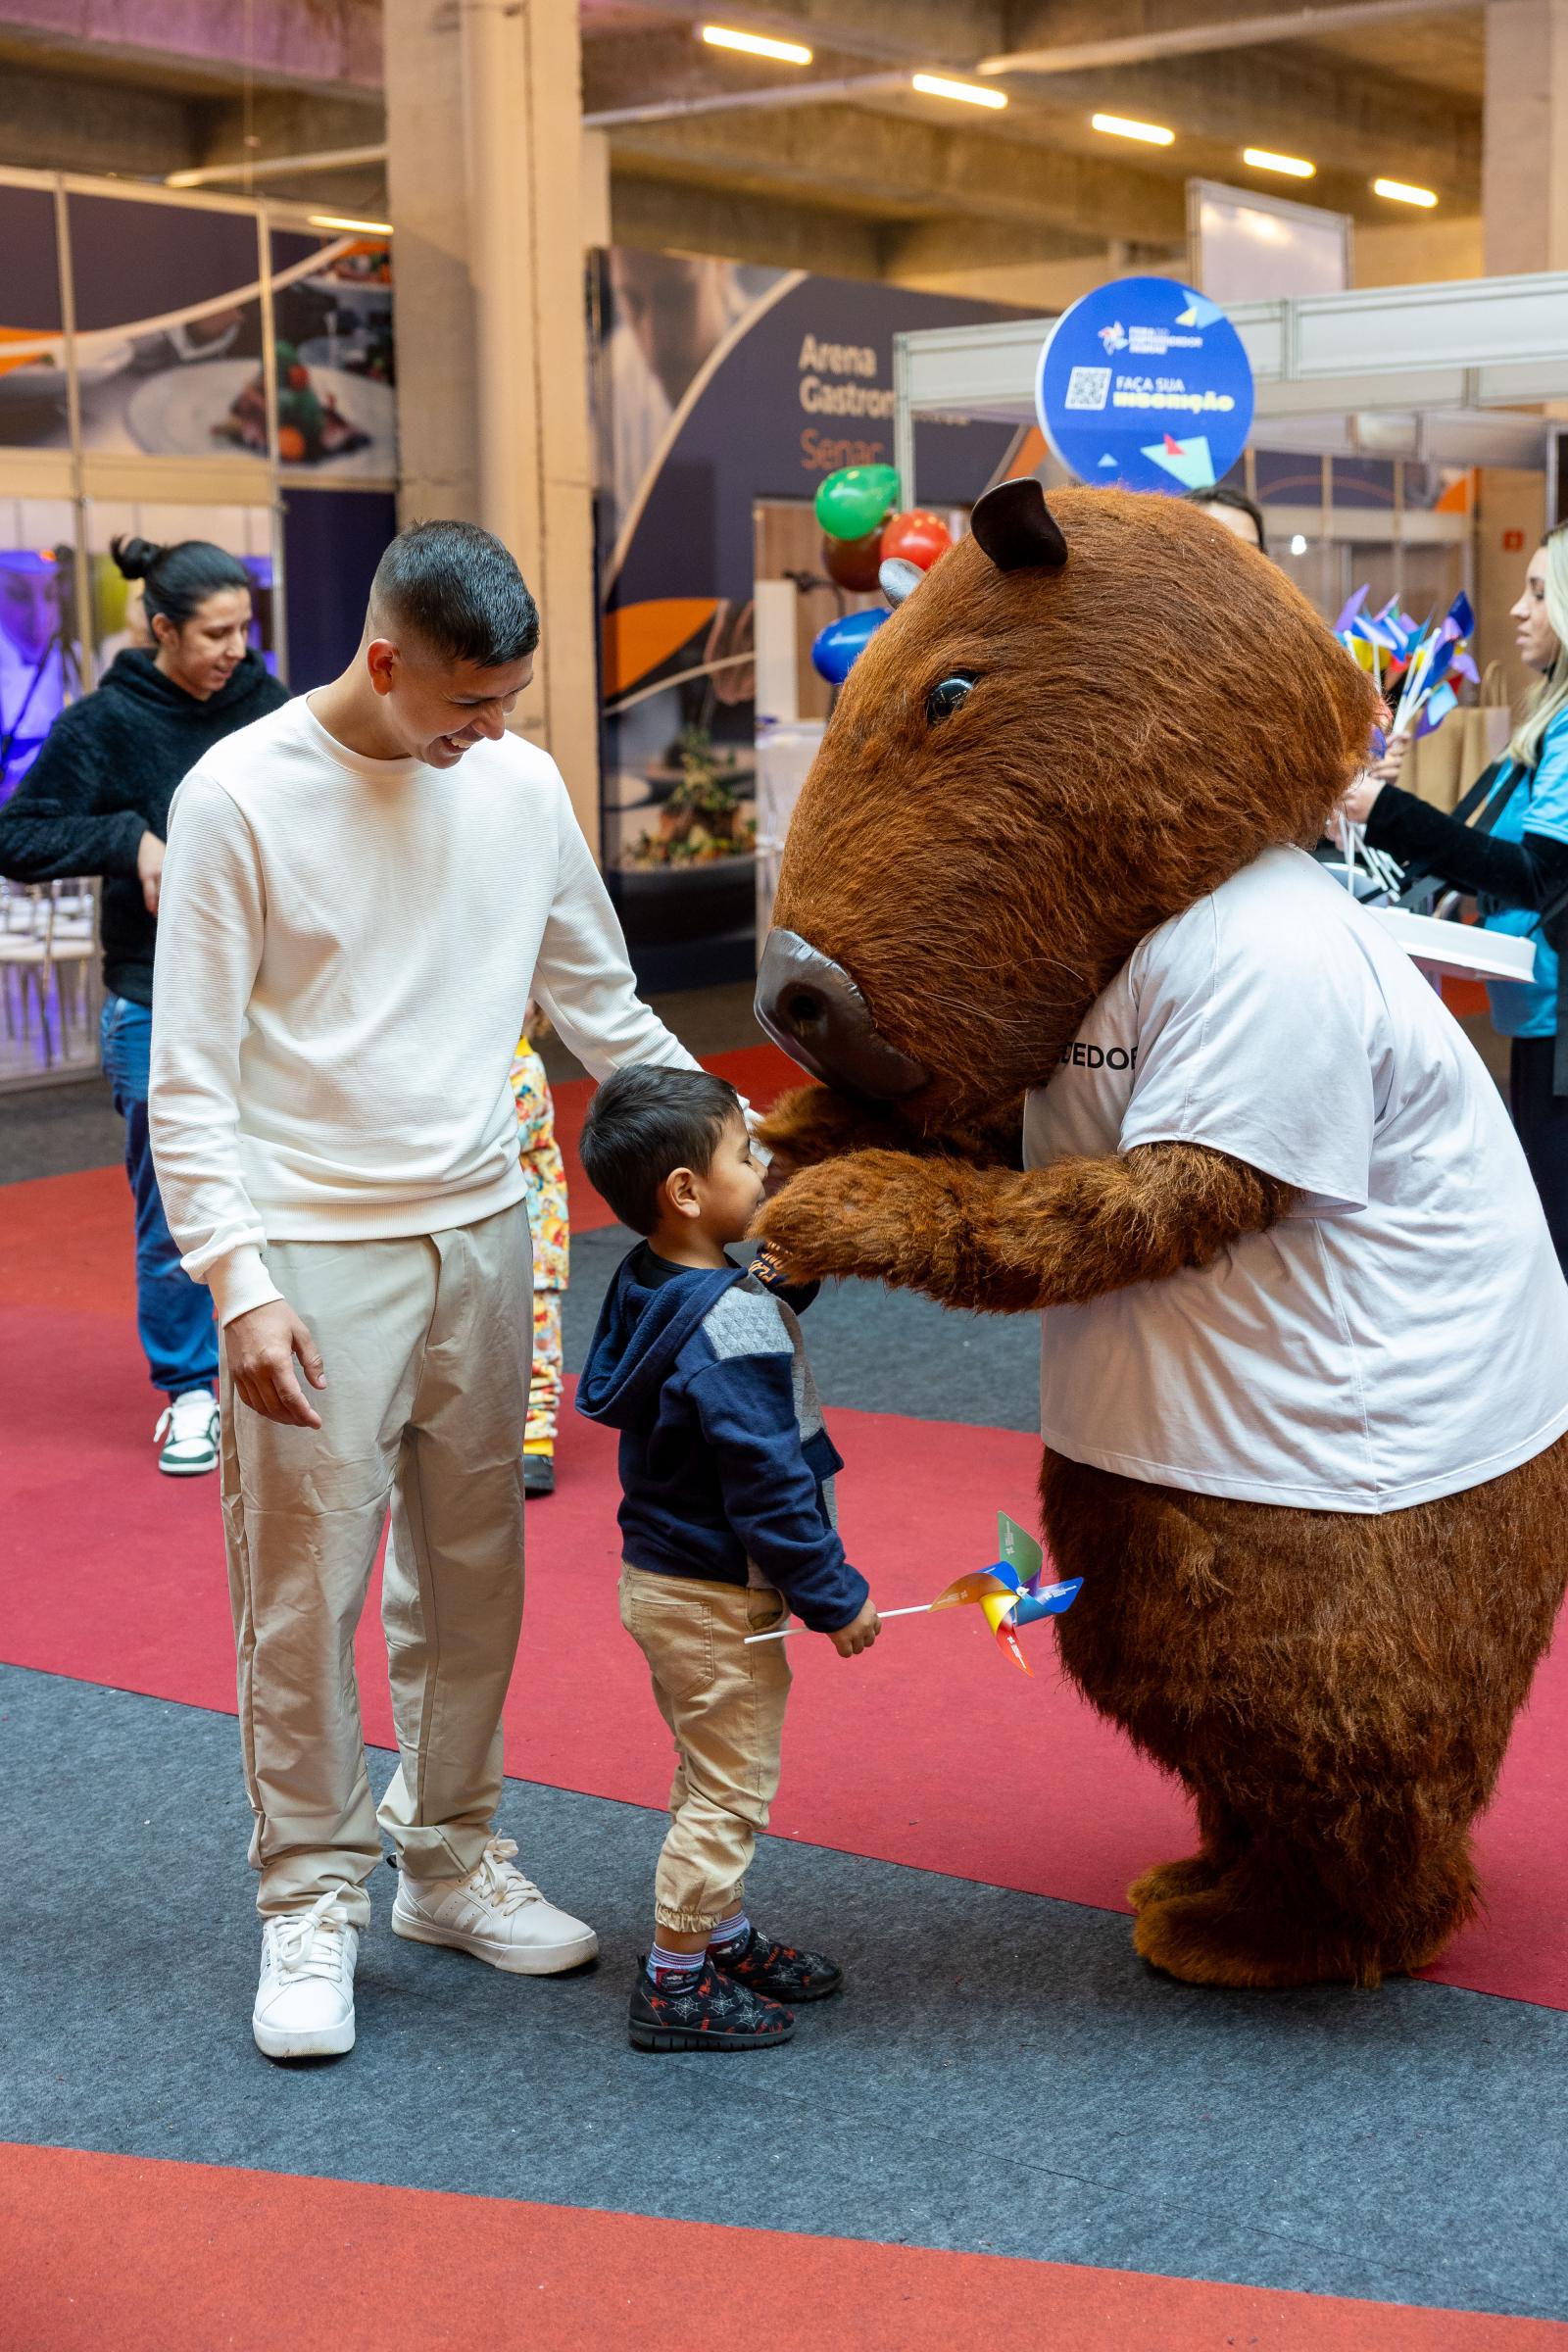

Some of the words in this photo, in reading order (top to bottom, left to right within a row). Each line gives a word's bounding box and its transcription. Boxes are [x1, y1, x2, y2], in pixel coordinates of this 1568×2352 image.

[799, 333, 877, 378] Arena
[1116, 375, 1154, 393] FAÇA
[1155, 377, 1186, 393] SUA
